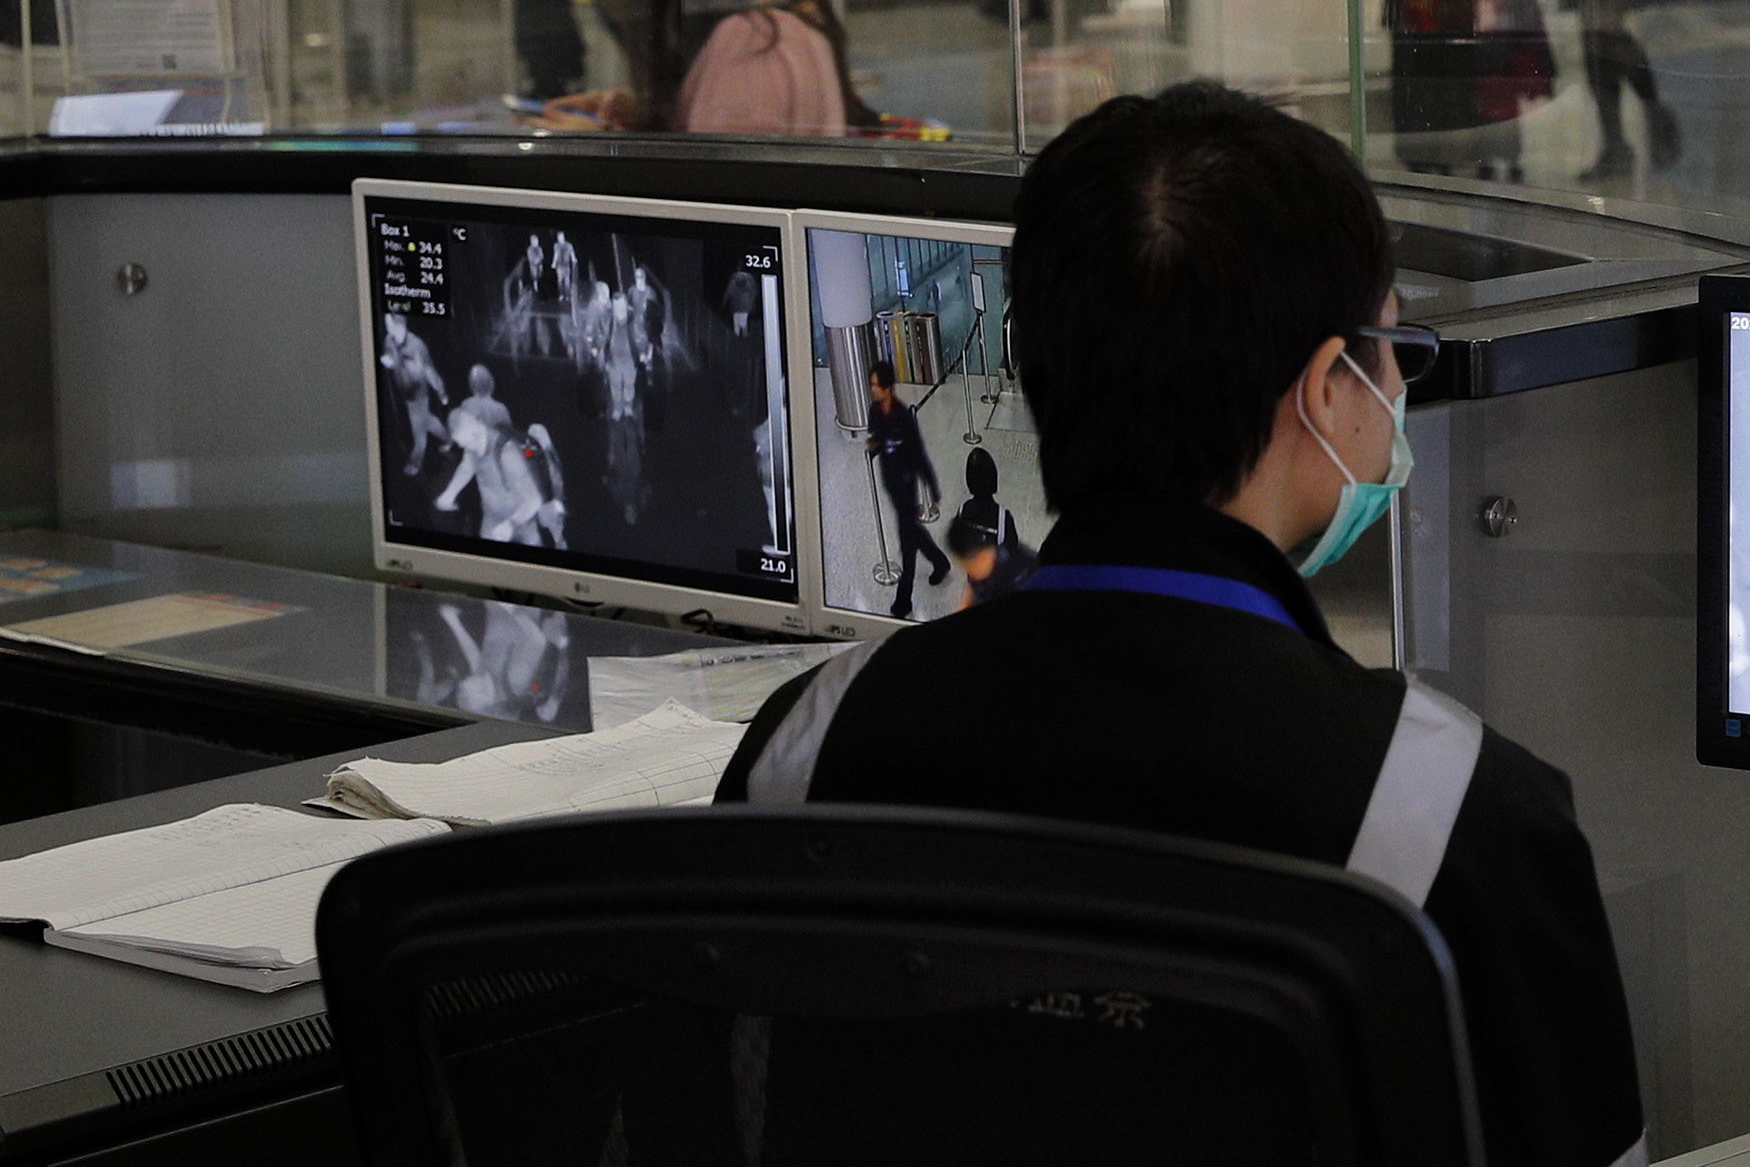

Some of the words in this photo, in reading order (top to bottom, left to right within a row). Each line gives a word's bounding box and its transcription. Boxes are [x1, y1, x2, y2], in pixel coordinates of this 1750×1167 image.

[381, 224, 399, 235] Box
[419, 241, 441, 254] 34.4
[420, 257, 442, 269] 20.3
[744, 253, 772, 269] 32.6
[385, 283, 430, 298] Isotherm
[423, 302, 445, 315] 35.5
[760, 557, 787, 574] 21.0
